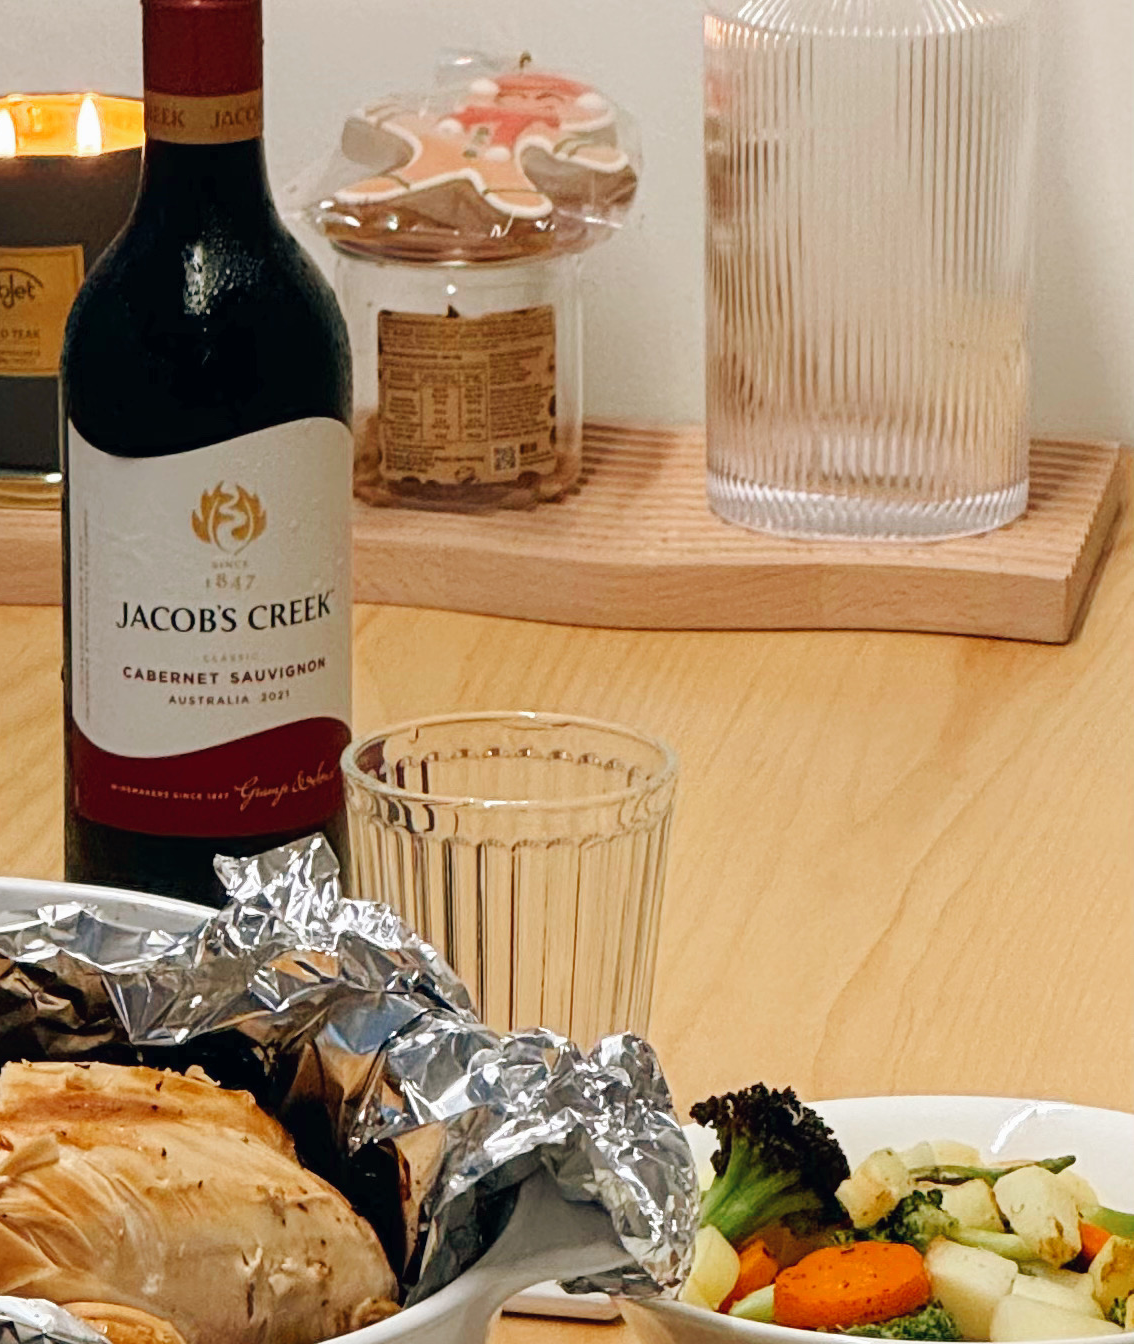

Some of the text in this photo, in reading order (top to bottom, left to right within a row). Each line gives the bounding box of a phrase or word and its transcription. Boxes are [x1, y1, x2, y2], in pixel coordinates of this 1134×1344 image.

[211, 560, 249, 570] SINCE
[205, 573, 257, 591] 1847
[116, 591, 331, 633] JACOB'S CREEK
[122, 656, 326, 686] CABERNET SAUVIGNON
[168, 690, 291, 706] AUSTRALIA 2021
